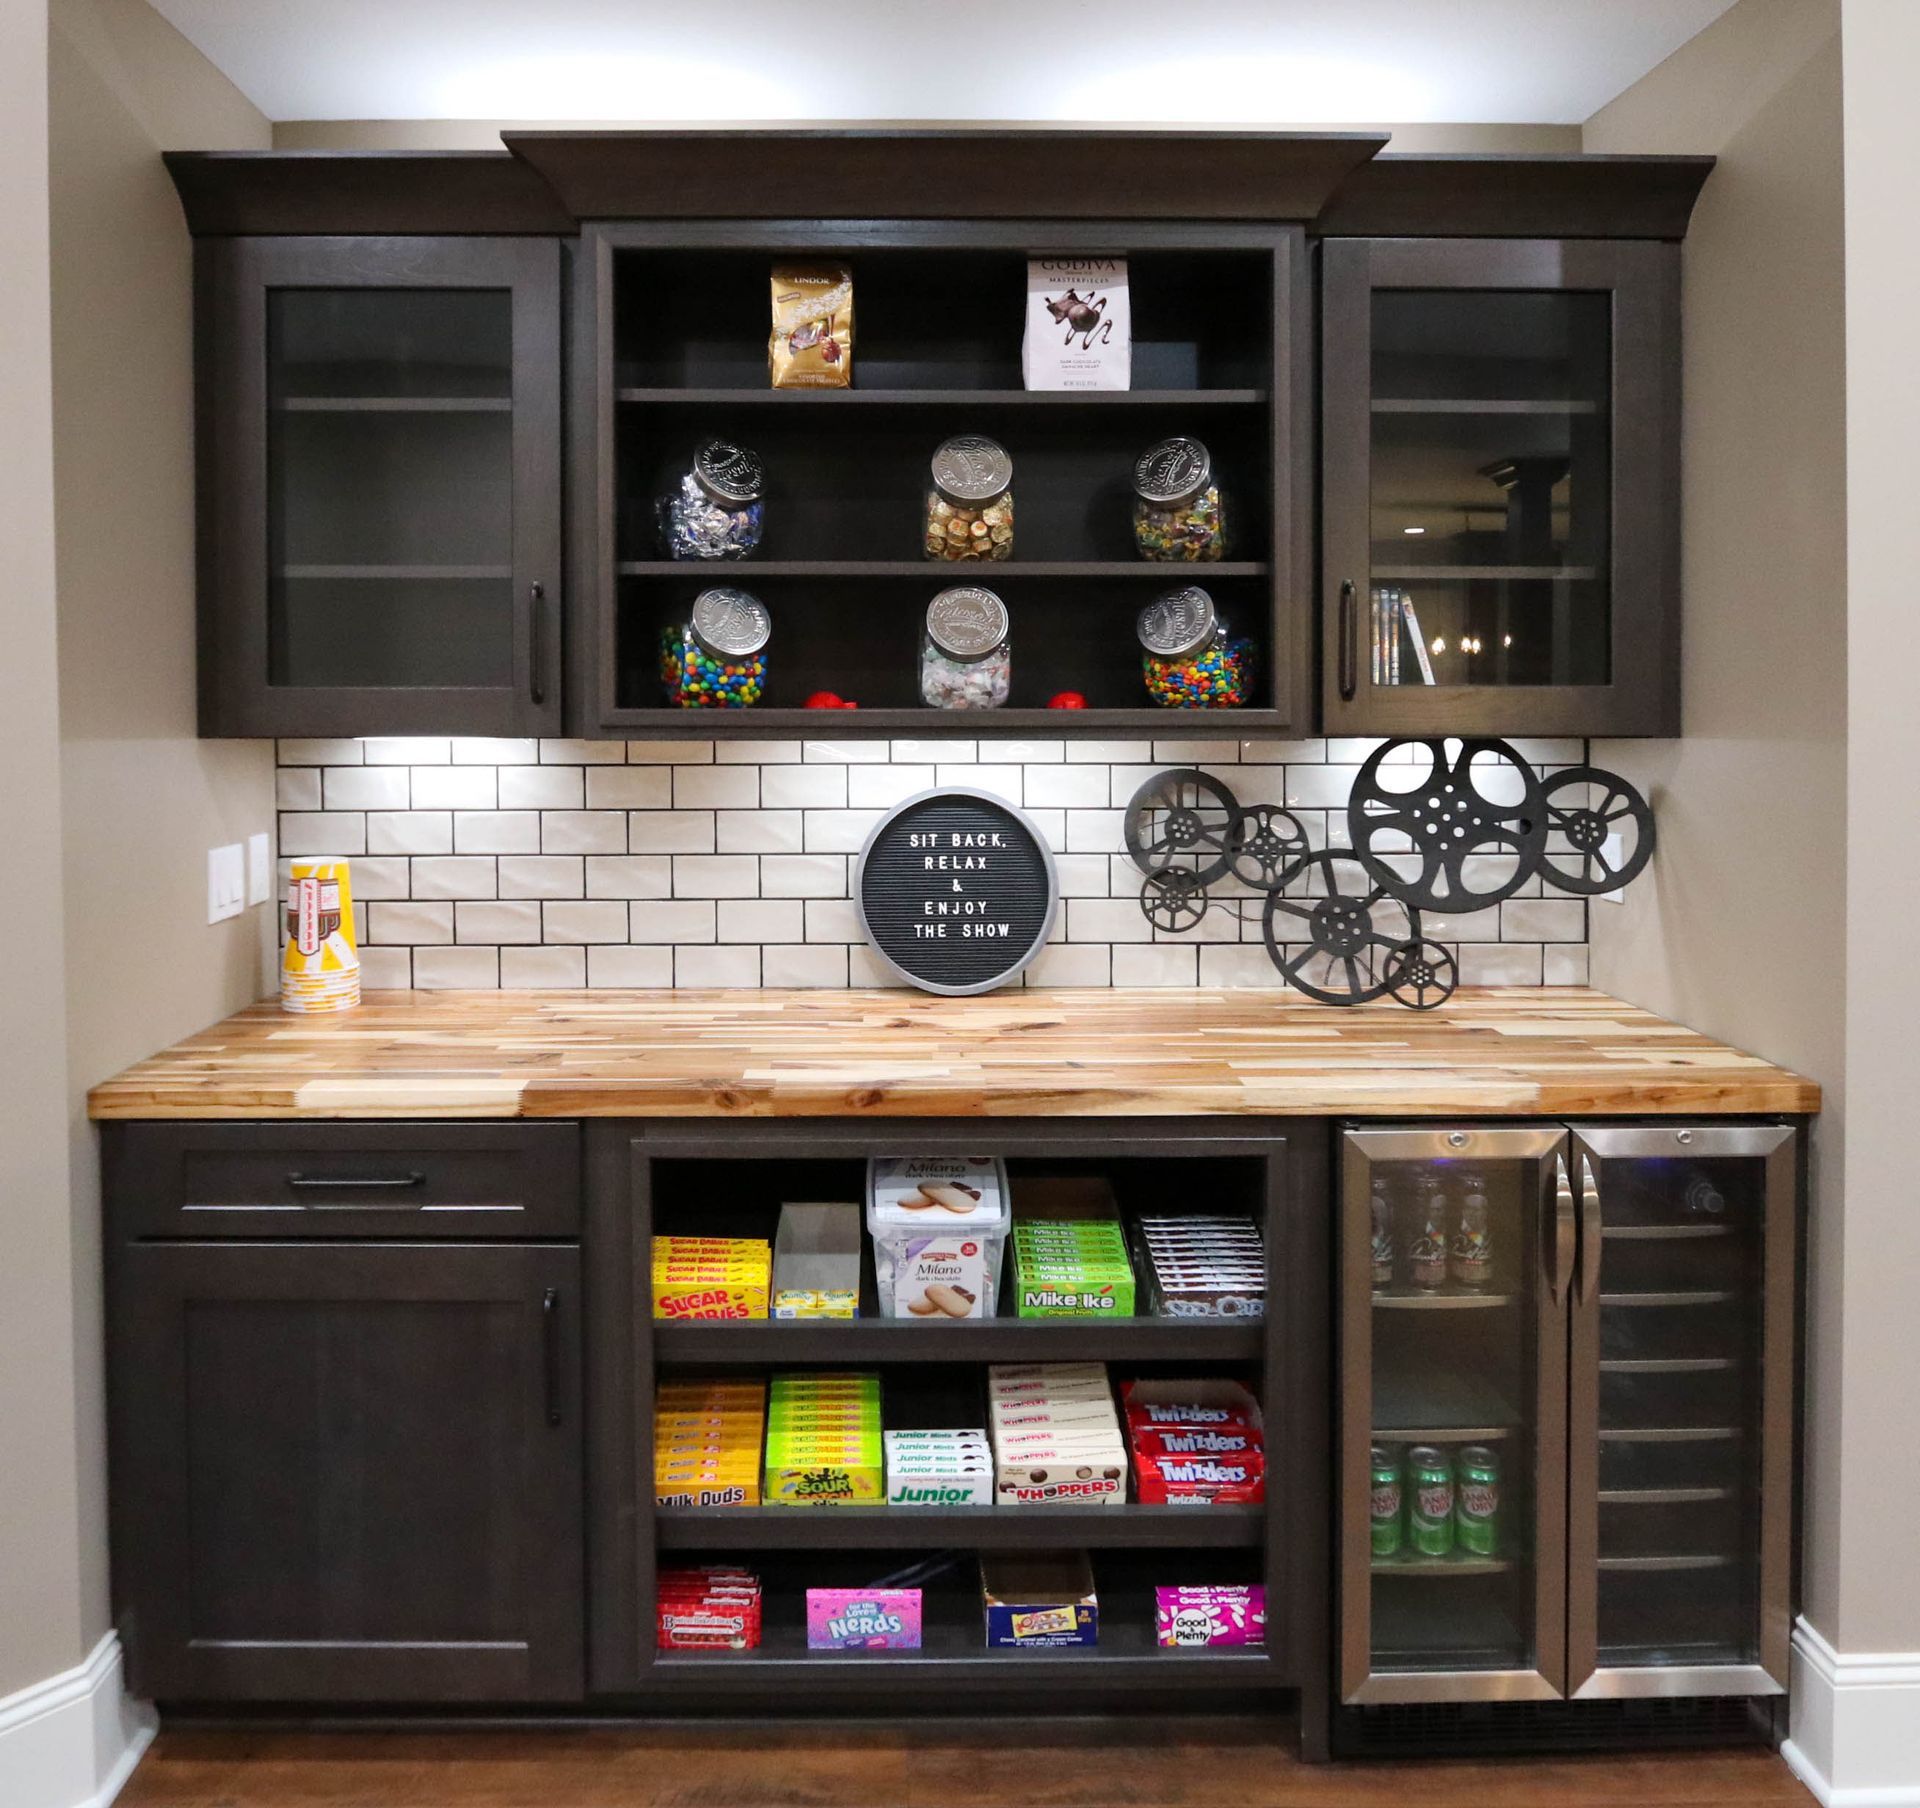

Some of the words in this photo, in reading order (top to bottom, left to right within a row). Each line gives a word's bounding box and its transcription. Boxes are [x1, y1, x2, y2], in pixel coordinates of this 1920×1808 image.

[1041, 260, 1116, 271] GODIVA
[794, 277, 830, 285] LINDOR
[910, 834, 938, 847] SIT
[924, 856, 987, 869] RELAX
[952, 879, 963, 892] &
[924, 901, 987, 915] ENJOY
[914, 924, 947, 938] THE
[962, 924, 1009, 937] SHOW
[905, 1162, 966, 1175] Milano
[915, 1264, 963, 1276] Milano
[658, 1290, 729, 1316] SUGAR
[1025, 1292, 1077, 1306] Mike
[1083, 1294, 1115, 1308] Ike
[800, 1480, 849, 1493] SOUR
[1009, 1480, 1117, 1501] WHOPPERS
[701, 1487, 744, 1506] Duds
[891, 1486, 974, 1502] Junior
[1176, 1618, 1206, 1627] Good
[1176, 1632, 1209, 1642] Plenty
